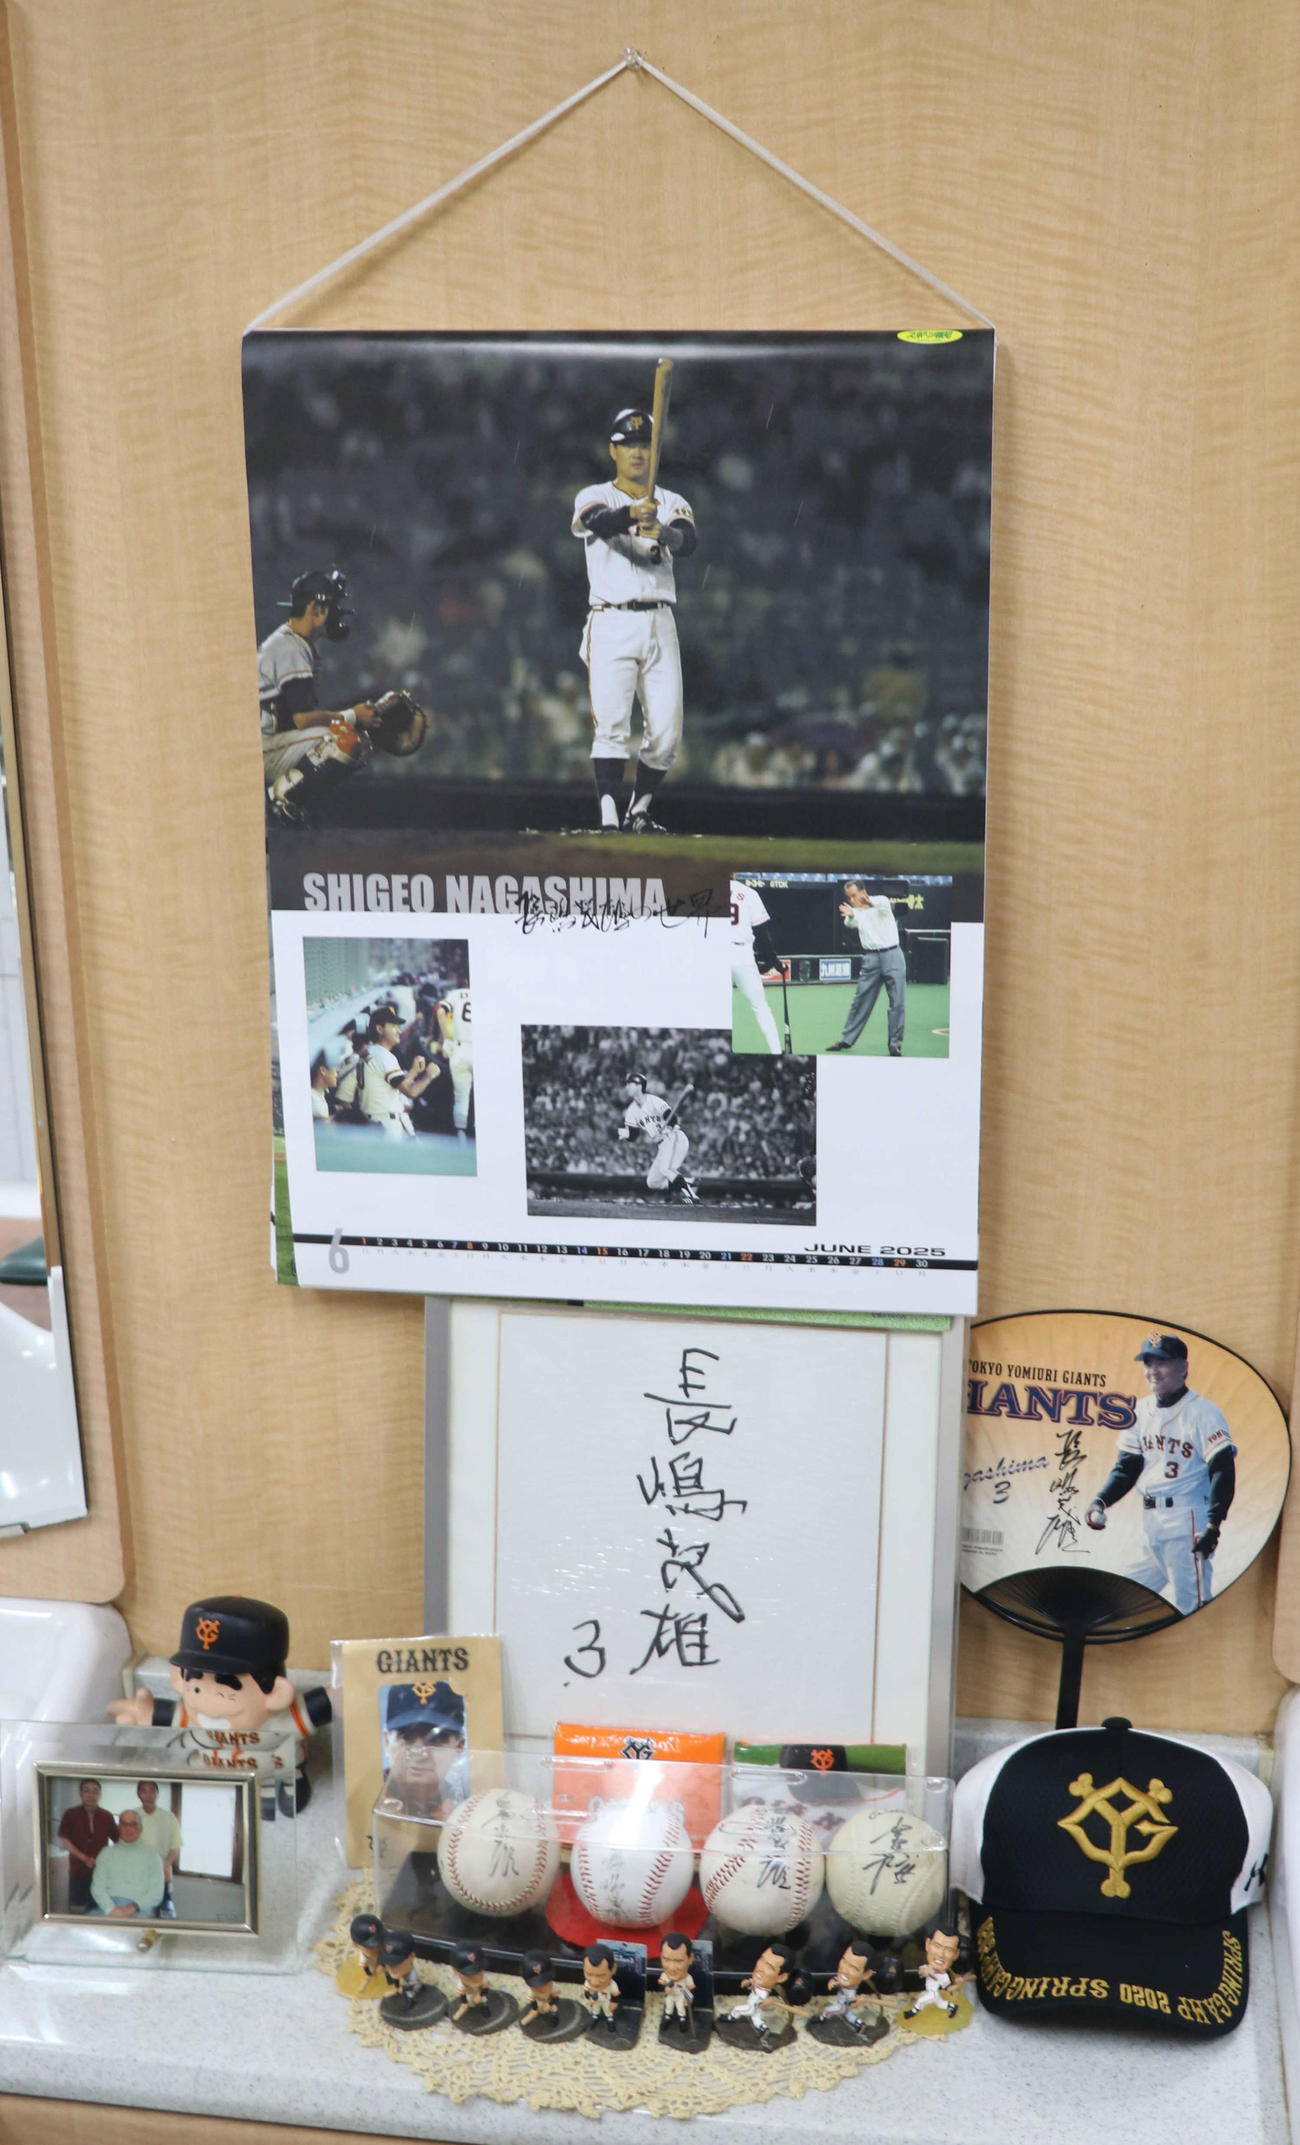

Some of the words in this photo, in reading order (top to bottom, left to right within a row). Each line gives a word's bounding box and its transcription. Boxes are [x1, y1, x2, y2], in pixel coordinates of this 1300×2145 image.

[303, 873, 434, 913] SHIGEO
[446, 874, 668, 916] NAGASHIMA
[328, 1227, 350, 1274] 6
[362, 1236, 367, 1245] 1
[376, 1237, 383, 1246] 2
[391, 1238, 398, 1247] 3
[406, 1239, 413, 1247] 4
[421, 1240, 428, 1248] 5
[437, 1240, 444, 1248] 6
[452, 1240, 458, 1249] 7
[466, 1241, 473, 1249] 8
[482, 1242, 488, 1250] 9
[498, 1242, 509, 1251] 10
[518, 1243, 528, 1252] 11
[536, 1245, 548, 1253] 12
[556, 1246, 568, 1254] 13
[576, 1246, 588, 1255] 14
[597, 1247, 608, 1256] 15
[617, 1248, 628, 1256] 16
[638, 1248, 649, 1257] 17
[658, 1249, 670, 1258] 18
[679, 1250, 690, 1259] 19
[699, 1251, 711, 1260] 20
[720, 1252, 732, 1260] 21
[740, 1253, 753, 1261] 22
[762, 1253, 775, 1262] 23
[784, 1254, 796, 1263] 24
[805, 1255, 818, 1264] 25
[827, 1256, 840, 1265] 26
[849, 1256, 861, 1265] 27
[871, 1257, 884, 1266] 28
[893, 1258, 906, 1267] 29
[915, 1259, 928, 1268] 30
[804, 1243, 873, 1254] JUNE
[880, 1245, 946, 1257] 2025
[1007, 1364, 1058, 1382] YOMIURI
[1062, 1371, 1107, 1387] GIANTS
[967, 1378, 1138, 1430] IANTS
[1164, 1461, 1179, 1479] 3
[993, 1481, 1011, 1504] 3
[376, 1647, 469, 1673] GIANTS
[564, 1619, 606, 1679] 3
[1119, 1983, 1172, 2015] 2020
